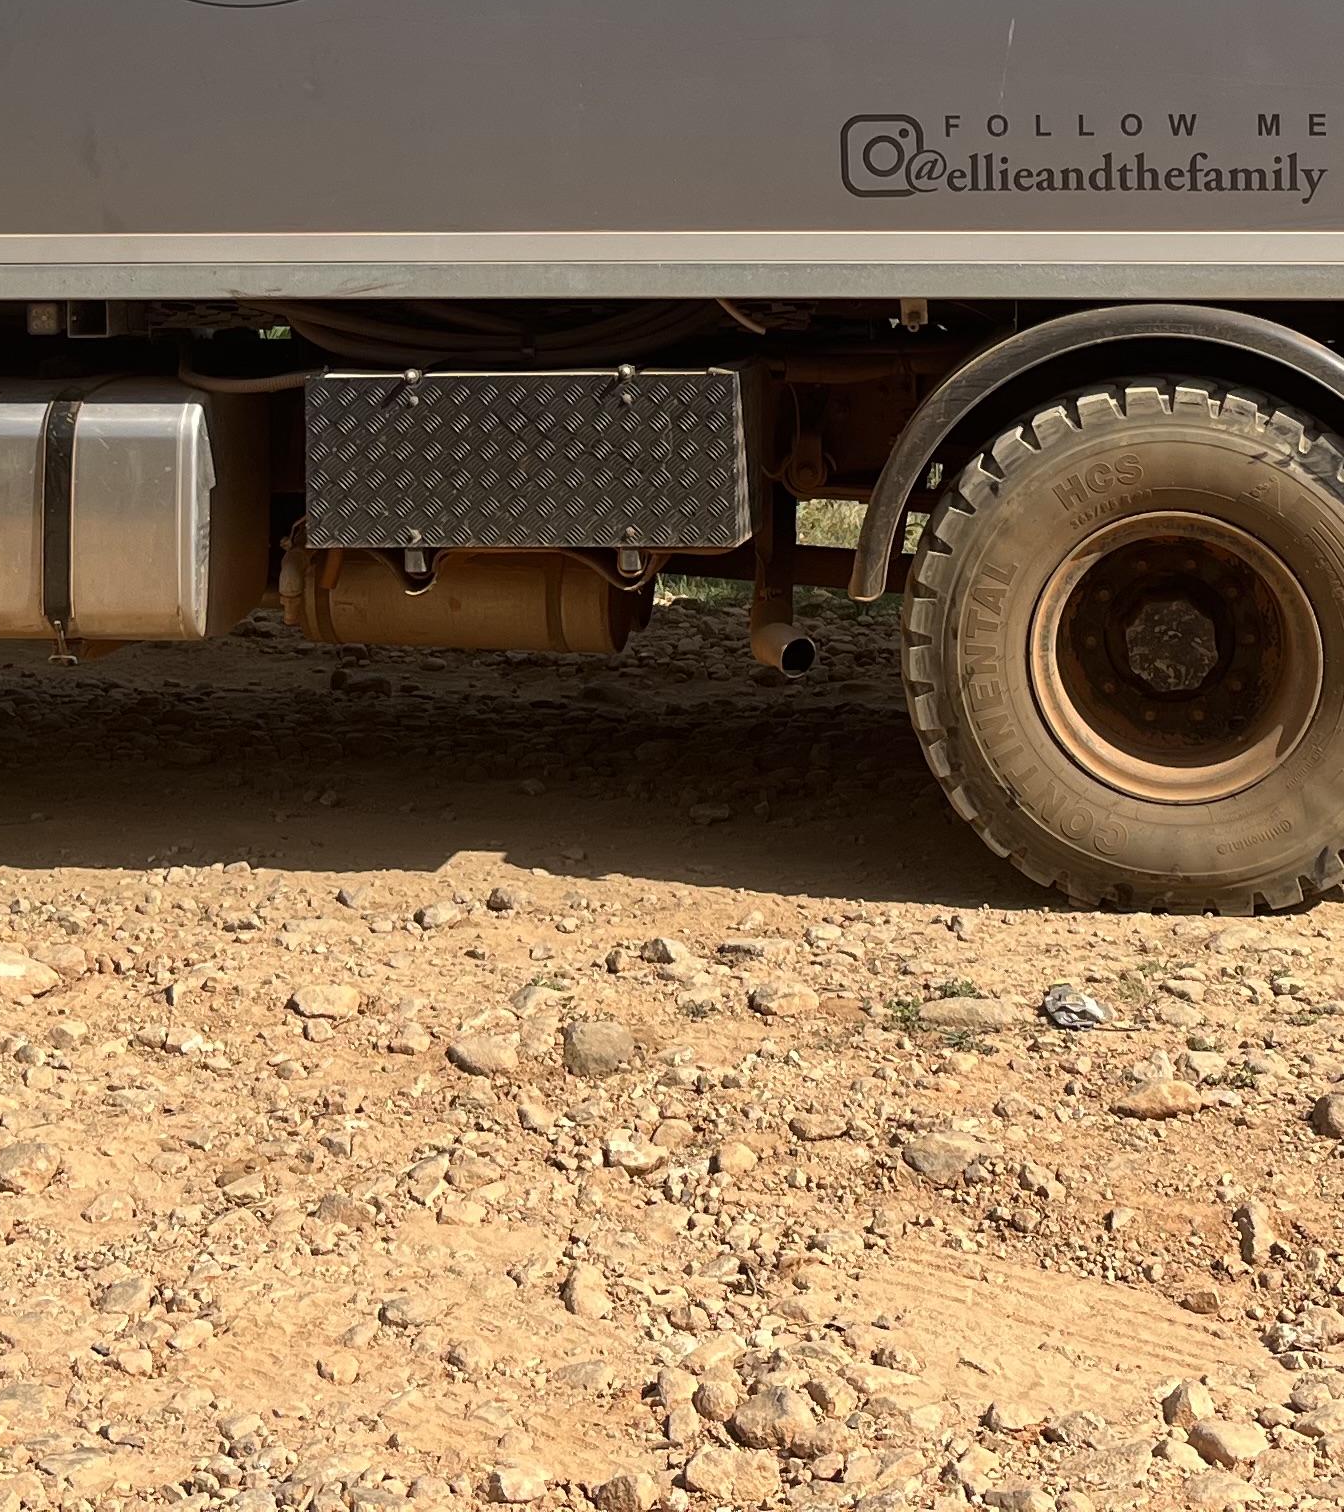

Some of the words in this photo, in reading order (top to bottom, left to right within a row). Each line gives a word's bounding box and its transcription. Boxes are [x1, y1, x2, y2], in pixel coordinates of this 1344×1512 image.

[944, 113, 1198, 138] FOLLOW
[1257, 112, 1328, 137] ME
[904, 149, 1329, 205] @ellieandthefamily
[1052, 453, 1145, 512] HCS
[964, 560, 1129, 857] CONTINENTAL
